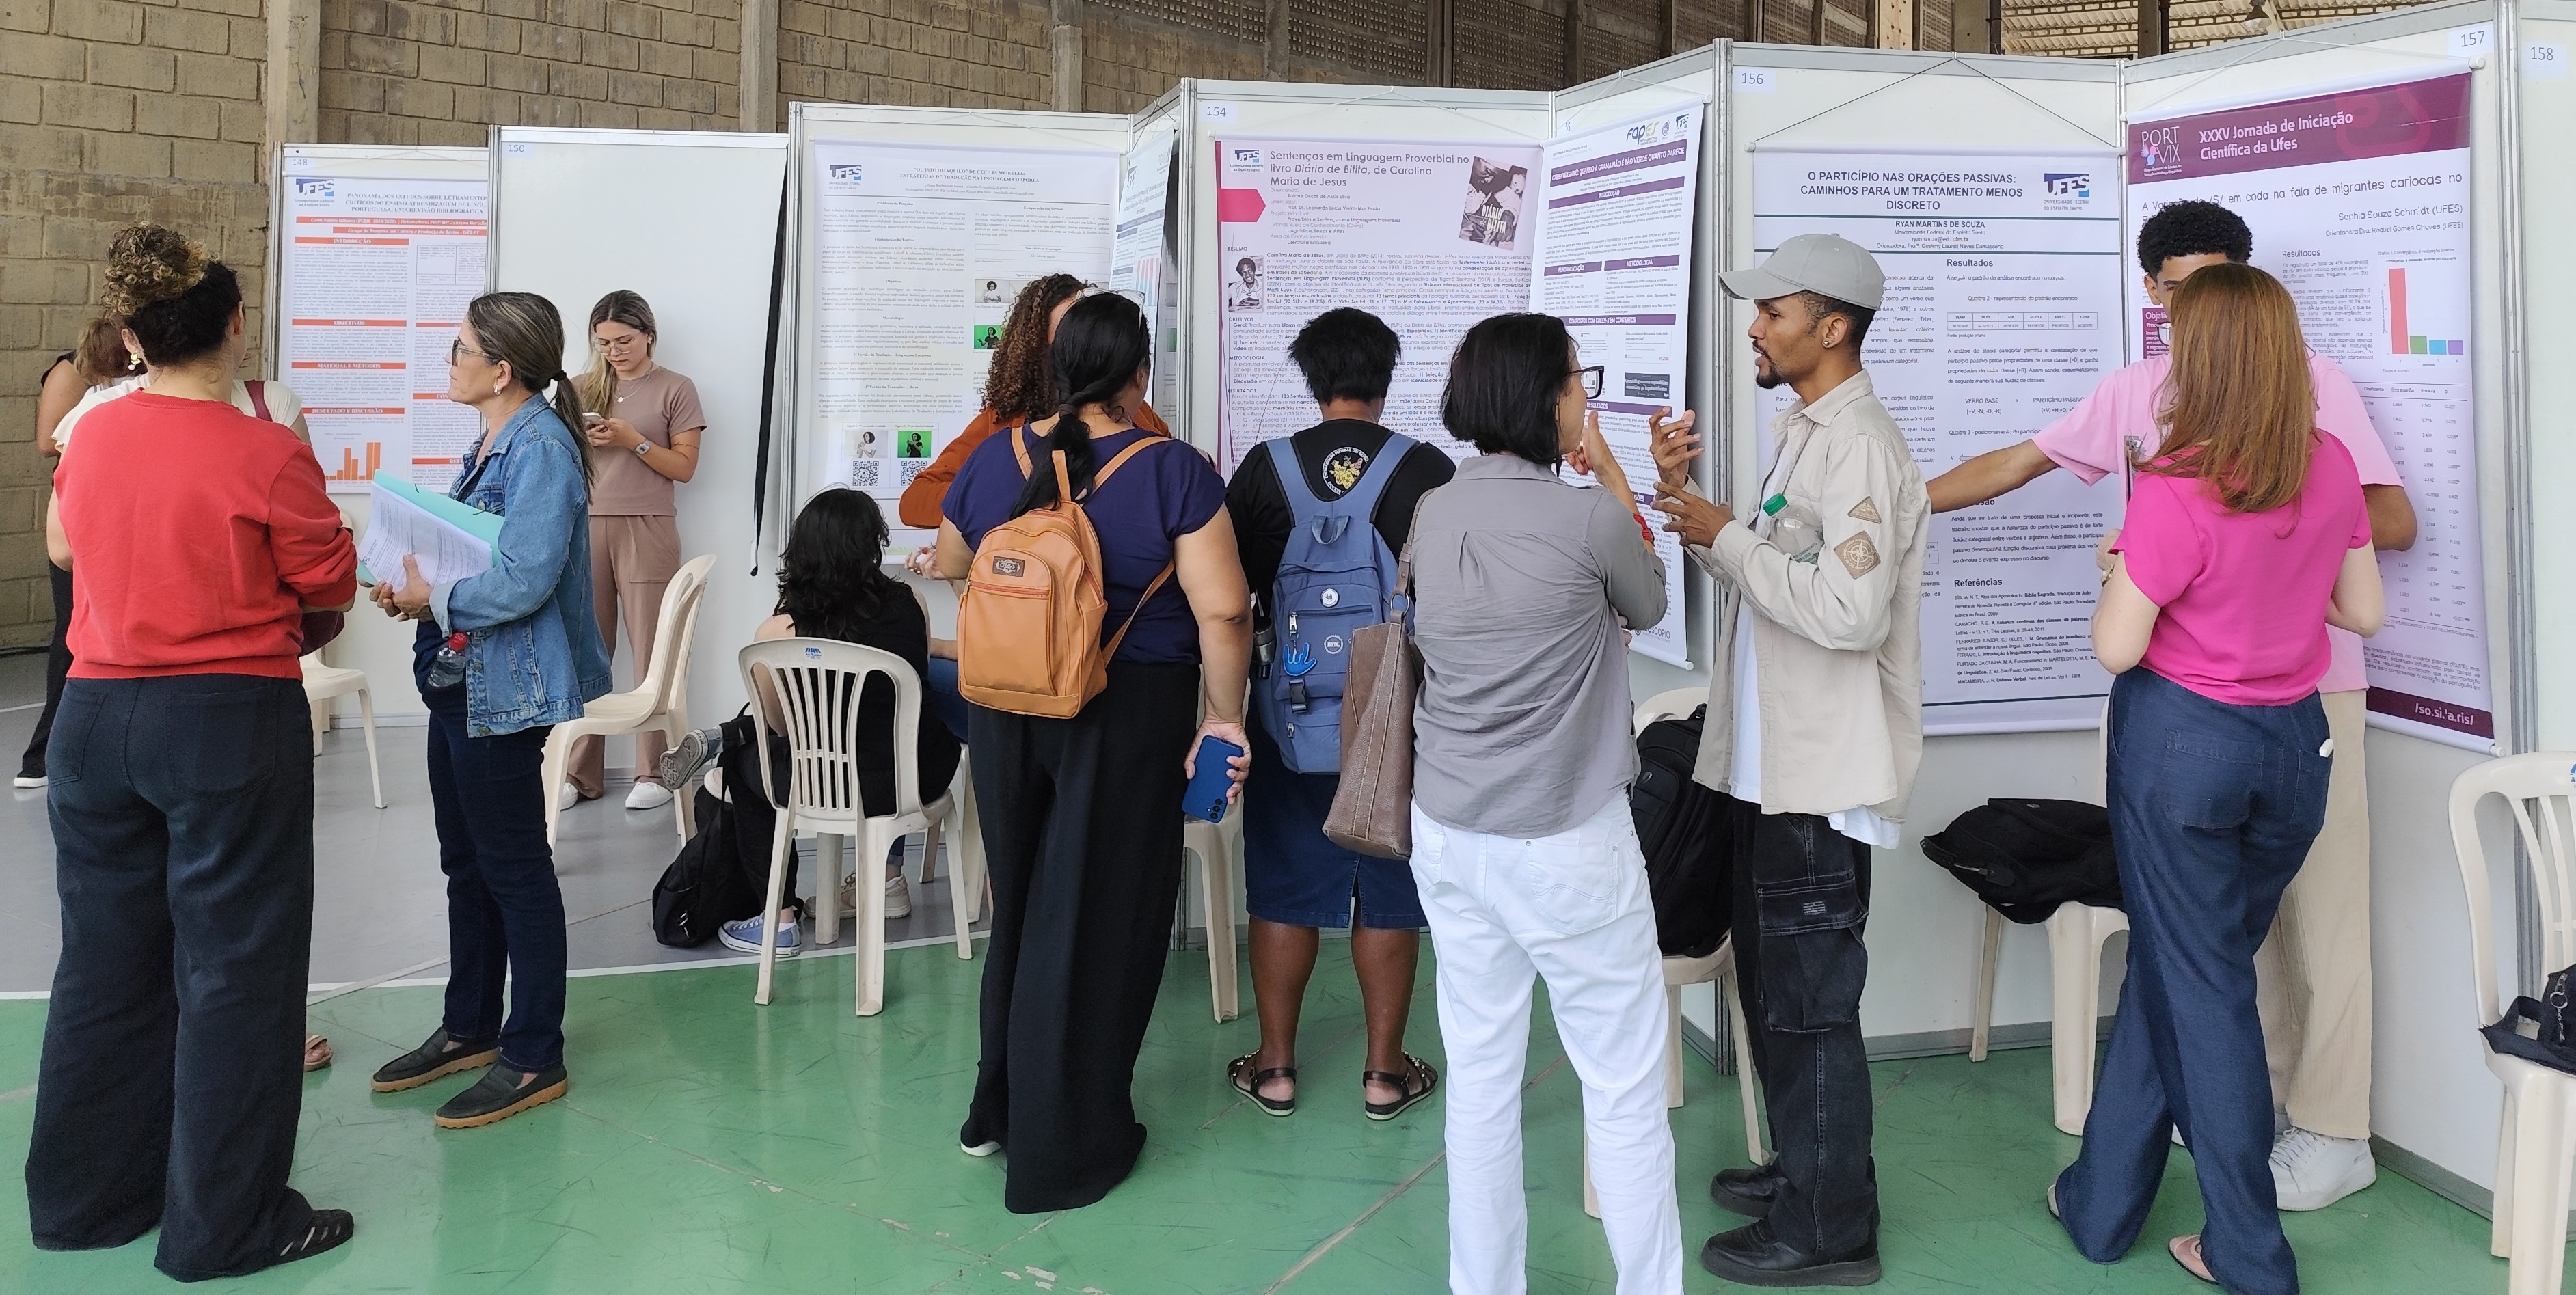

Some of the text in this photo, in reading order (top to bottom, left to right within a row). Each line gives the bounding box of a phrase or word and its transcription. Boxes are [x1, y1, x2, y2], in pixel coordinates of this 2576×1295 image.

[2461, 31, 2485, 47] 157
[2531, 46, 2553, 61] 158
[1741, 73, 1763, 85] 156
[1206, 106, 1226, 117] 154
[2199, 111, 2353, 144] XXXV Jornada de Iniciação
[2141, 126, 2180, 147] PORT
[2156, 144, 2181, 164] VIX
[2201, 137, 2298, 160] Científica da Ufes
[1270, 151, 1323, 162] Sentenças
[1346, 152, 1402, 163] Linguagem
[1405, 154, 1454, 163] Proverbial
[1612, 159, 1621, 169] NÃO
[1633, 154, 1647, 163] VERDE
[1649, 152, 1666, 162] QUANTO
[1667, 147, 1685, 157] PARECE
[1271, 164, 1291, 173] livro
[1294, 163, 1323, 173] Diário
[1327, 165, 1340, 174] de
[1344, 165, 1370, 175] Bitita,
[1390, 166, 1432, 175] Carolina
[1808, 169, 2016, 184] O PARTICÍPIO NAS ORAÇÕES PASSIVAS:
[1271, 176, 1347, 186] Maria de Jesus
[1801, 185, 2023, 197] CAMINHOS PARA UM TRATAMENTO MENOS
[2142, 202, 2148, 211] A
[2229, 193, 2241, 204] em
[2246, 190, 2268, 202] coda
[2273, 189, 2286, 199] na
[2290, 187, 2309, 197] fala
[2314, 185, 2327, 195] de
[2332, 180, 2385, 195] migrantes
[2391, 174, 2441, 189] cariocas
[2448, 174, 2463, 183] no
[1481, 204, 1502, 219] DIÁRIO
[1886, 200, 1940, 210] DISCRETO
[2339, 204, 2463, 221] Sophia Souza Schmidt (UFES)
[1487, 218, 1506, 234] BITITA
[2325, 228, 2358, 236] Orientadora
[2393, 224, 2415, 232] Gomes
[2415, 223, 2441, 231] Chaves
[2443, 221, 2463, 230] (UFES)
[2282, 249, 2321, 258] Resultados
[1947, 259, 1993, 267] Resultados
[2145, 312, 2168, 321] Objetiv
[1954, 577, 2003, 588] Referências
